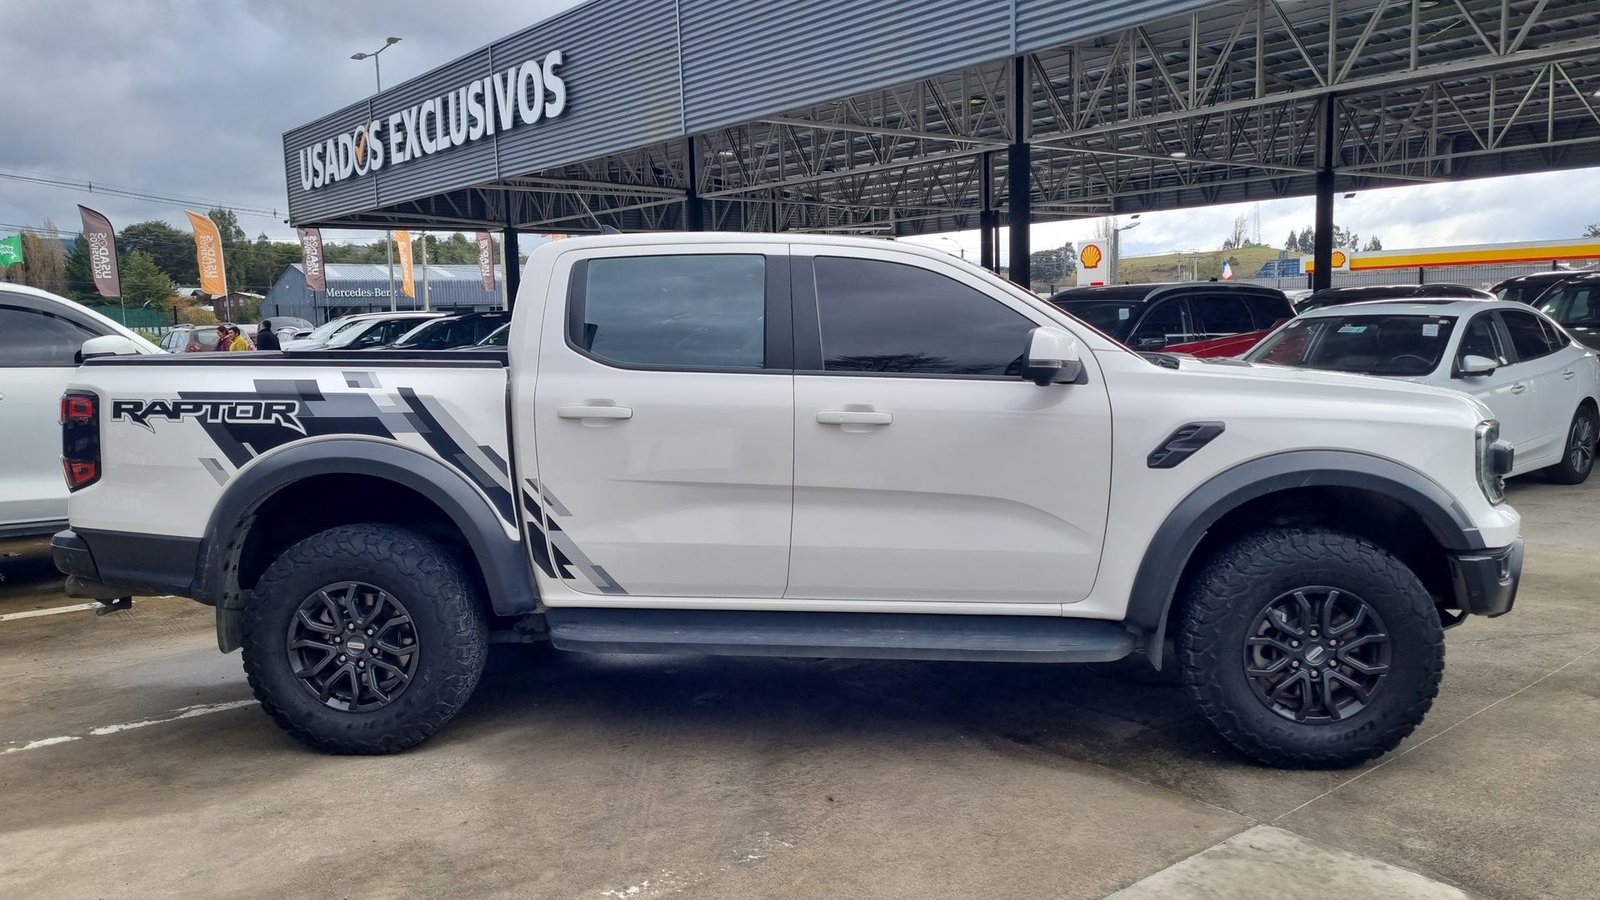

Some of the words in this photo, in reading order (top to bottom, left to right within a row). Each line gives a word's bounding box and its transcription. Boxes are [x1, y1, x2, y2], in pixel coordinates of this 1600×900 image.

[300, 120, 384, 191] USADOS
[389, 50, 567, 165] EXCLUSIVOS
[111, 399, 308, 436] RAPTOR
